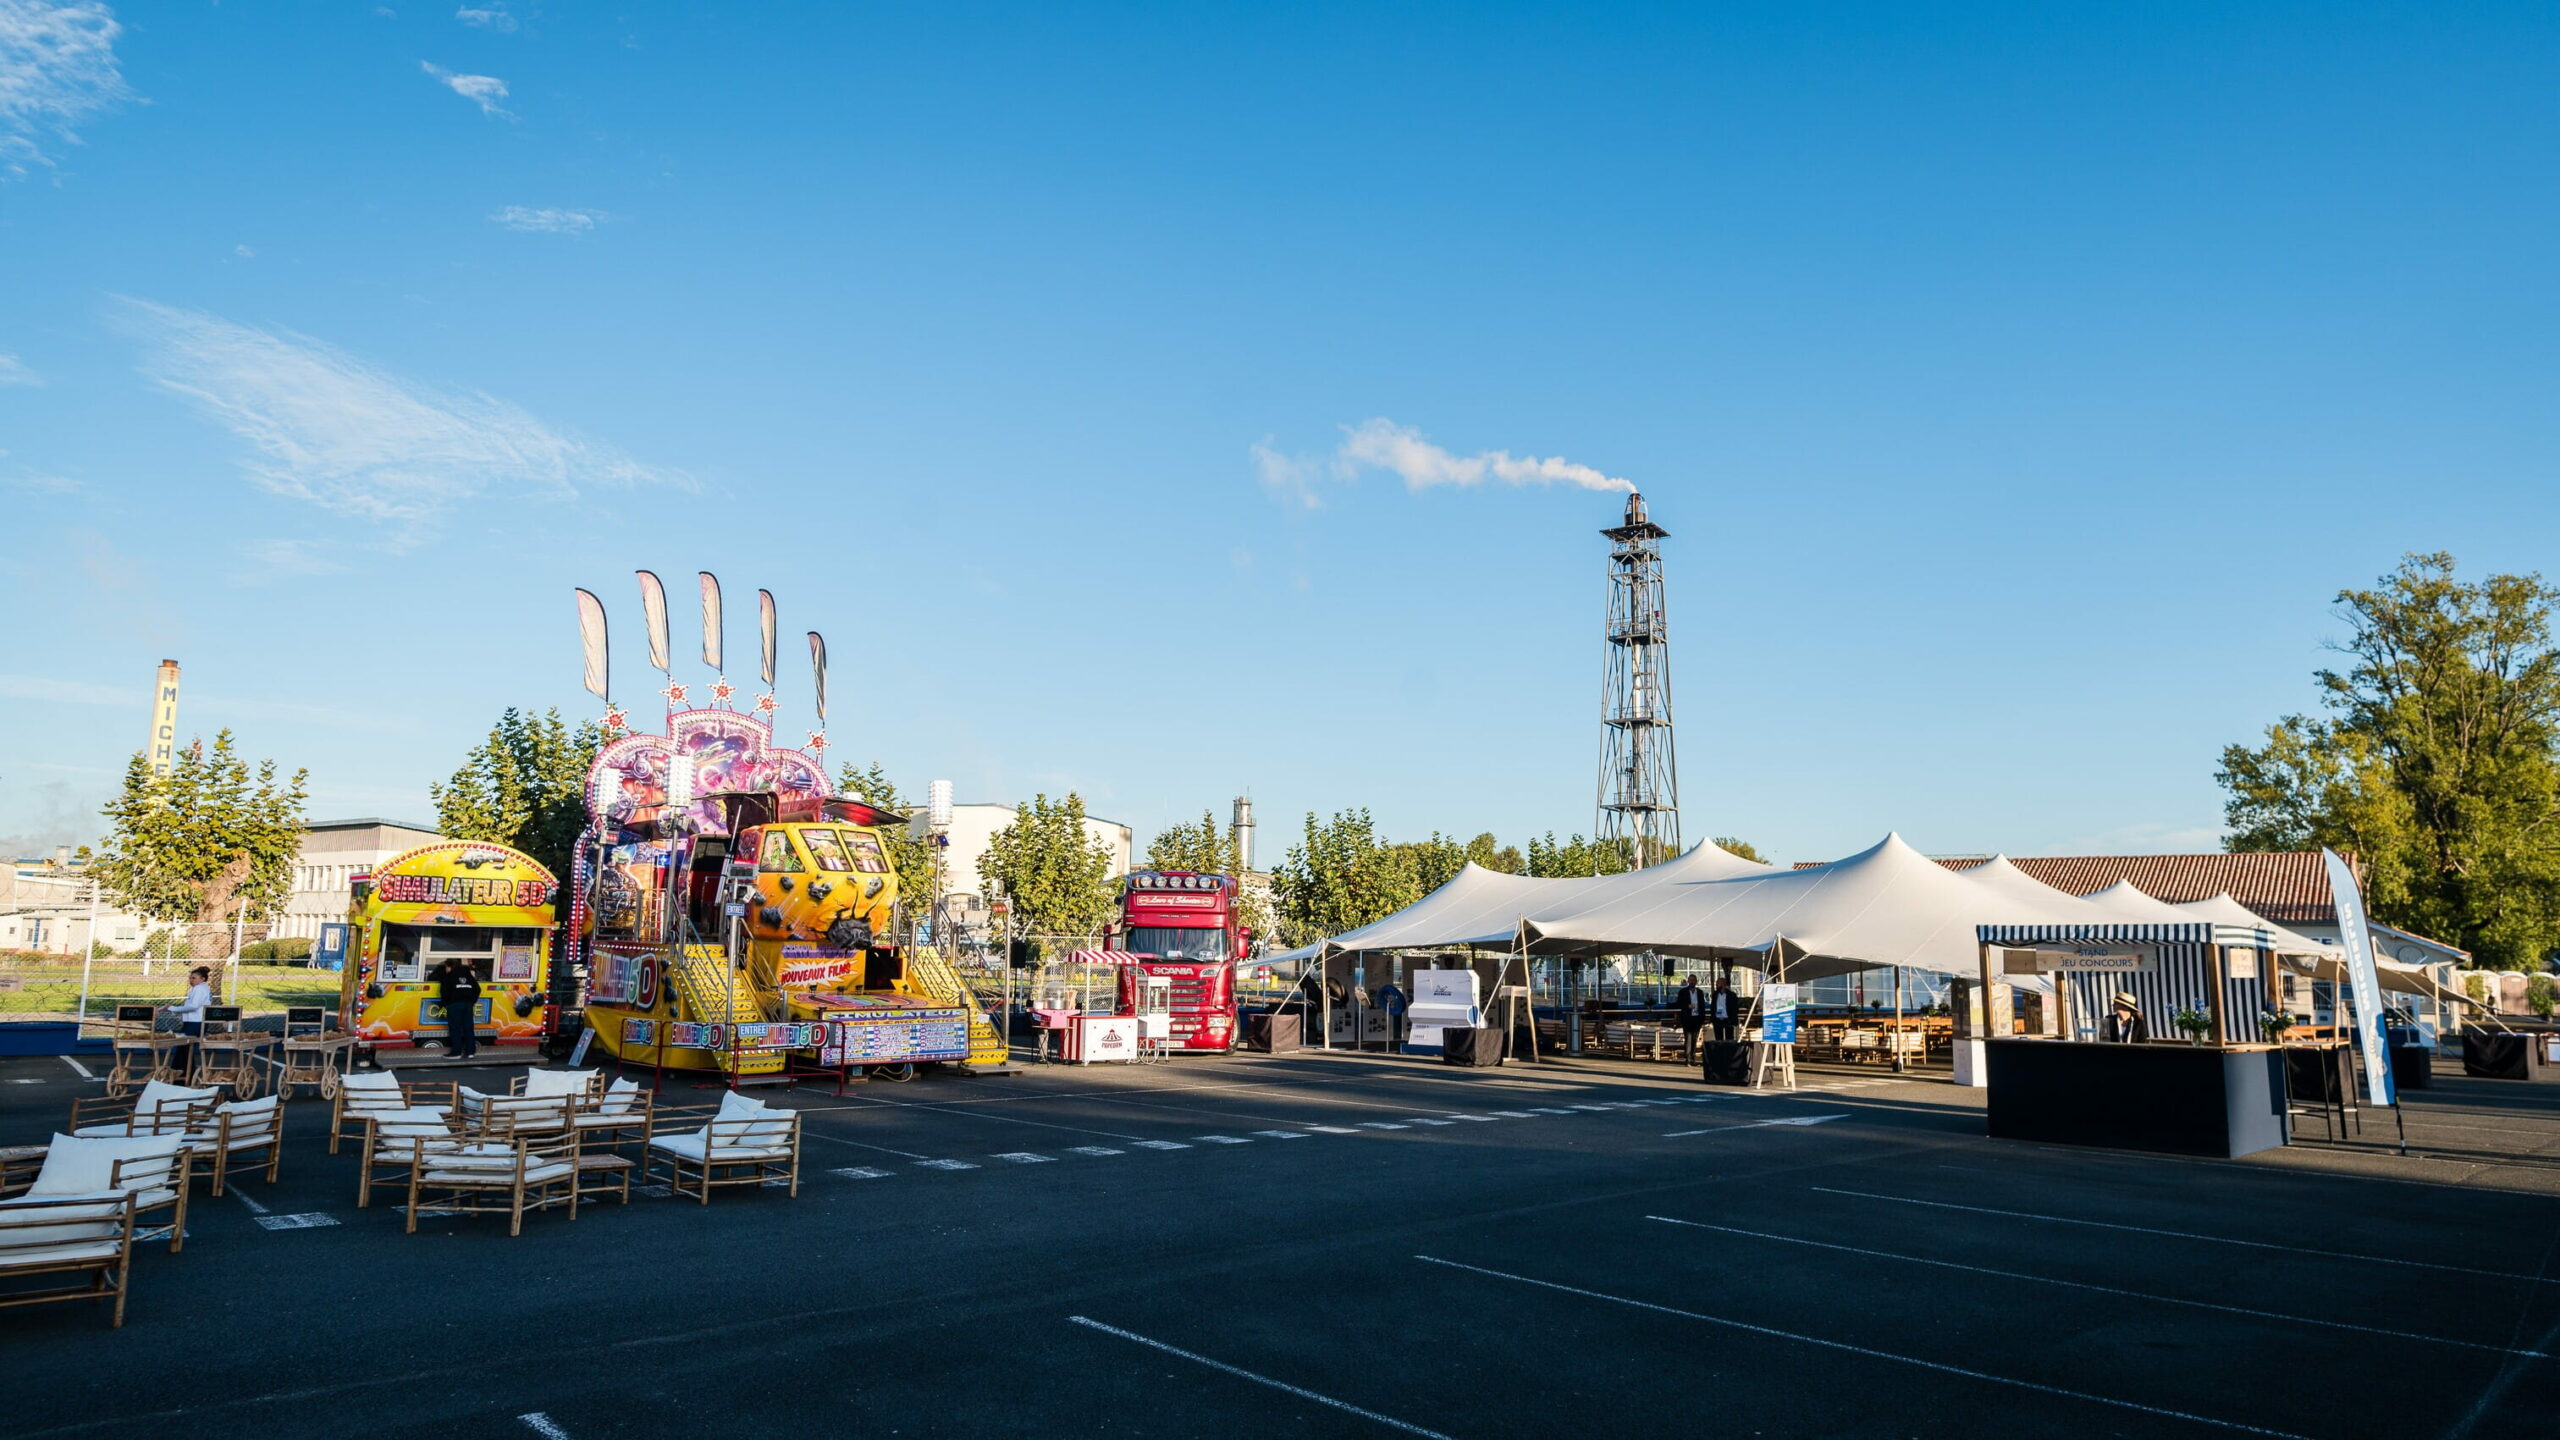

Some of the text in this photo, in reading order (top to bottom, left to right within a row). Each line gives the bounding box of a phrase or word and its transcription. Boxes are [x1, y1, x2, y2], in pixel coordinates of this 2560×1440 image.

[154, 686, 177, 778] MICHE
[378, 874, 548, 907] SIMULATEUR 5D
[2060, 959, 2134, 967] JEU CONCOURS
[2079, 948, 2109, 956] STAND
[626, 953, 659, 1009] 5D
[781, 962, 852, 985] NOUVEAUX FILMS
[1153, 967, 1194, 975] SCANIA
[427, 1003, 485, 1019] CAE
[827, 1009, 966, 1021] SIMULATEUR
[701, 1023, 725, 1048] 5D
[799, 1023, 828, 1047] 5D
